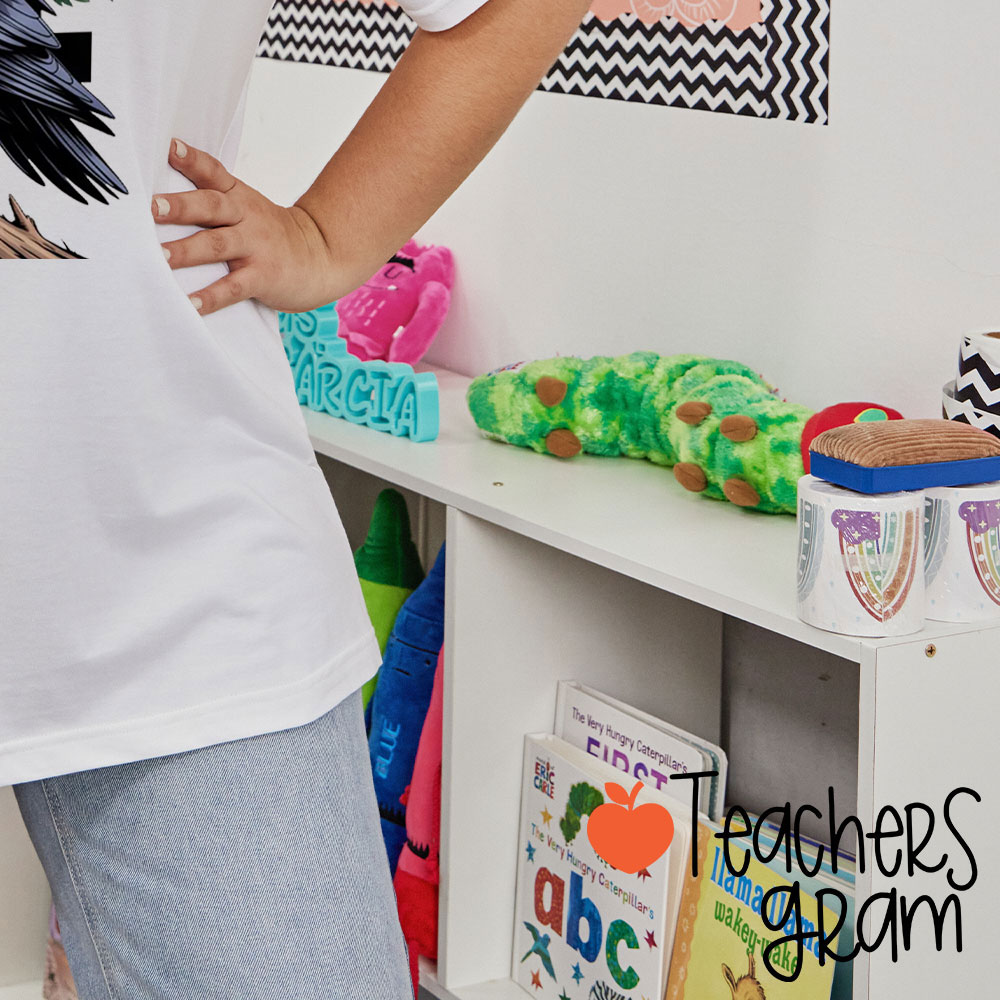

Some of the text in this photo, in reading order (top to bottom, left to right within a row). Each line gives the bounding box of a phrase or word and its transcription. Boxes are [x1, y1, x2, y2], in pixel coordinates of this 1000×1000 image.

[375, 717, 402, 780] BLUE
[535, 761, 556, 785] ERIC
[572, 706, 689, 775] The Very Hungry Caterpillar's
[534, 776, 555, 800] CARLE
[531, 822, 655, 920] The Very Hungry Caterpillar's
[534, 866, 640, 990] abc
